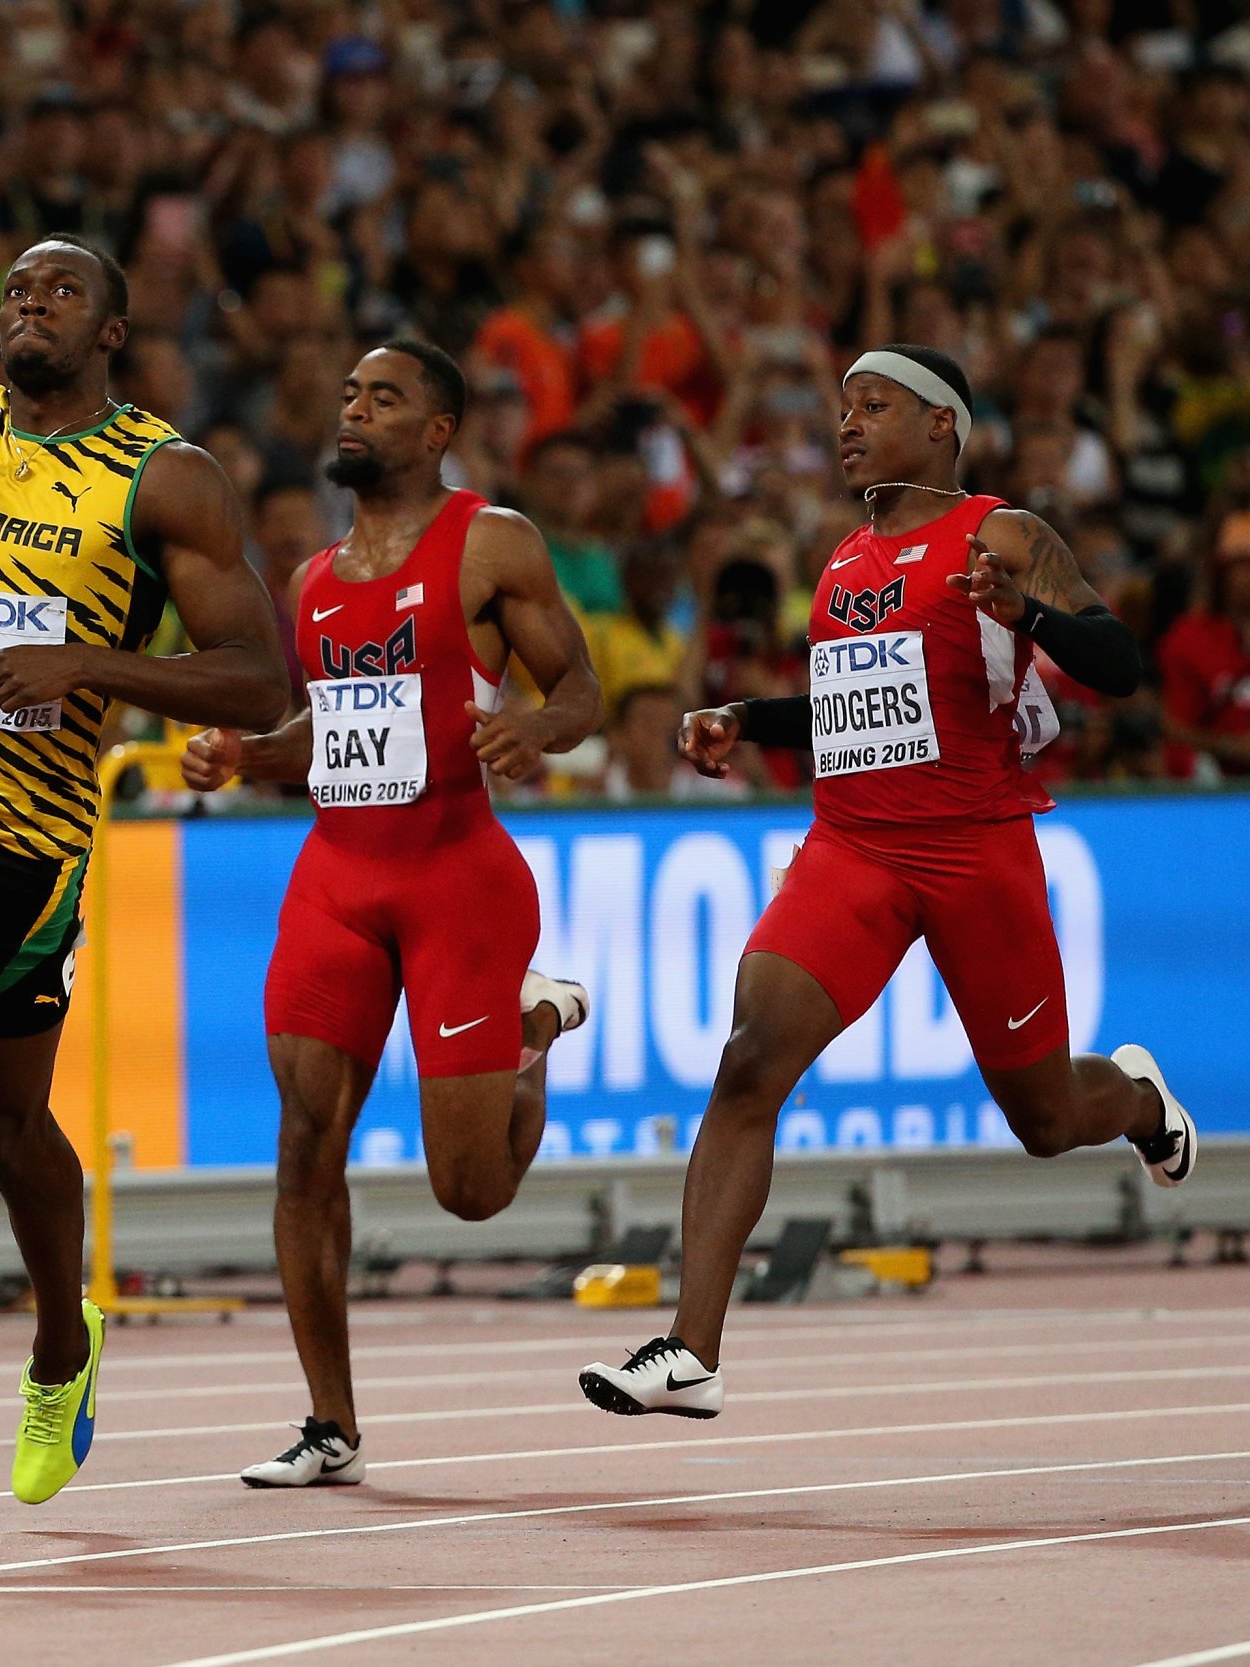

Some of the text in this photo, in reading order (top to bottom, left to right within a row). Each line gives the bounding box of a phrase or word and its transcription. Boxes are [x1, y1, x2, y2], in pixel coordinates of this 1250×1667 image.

[827, 574, 907, 634] USA
[320, 613, 417, 679] USA
[829, 637, 910, 674] TDK
[327, 681, 406, 711] TDK
[813, 682, 922, 737] RODGERS
[325, 727, 391, 770] GAY
[819, 738, 930, 773] BEIJING 2015
[376, 780, 419, 801] 2015
